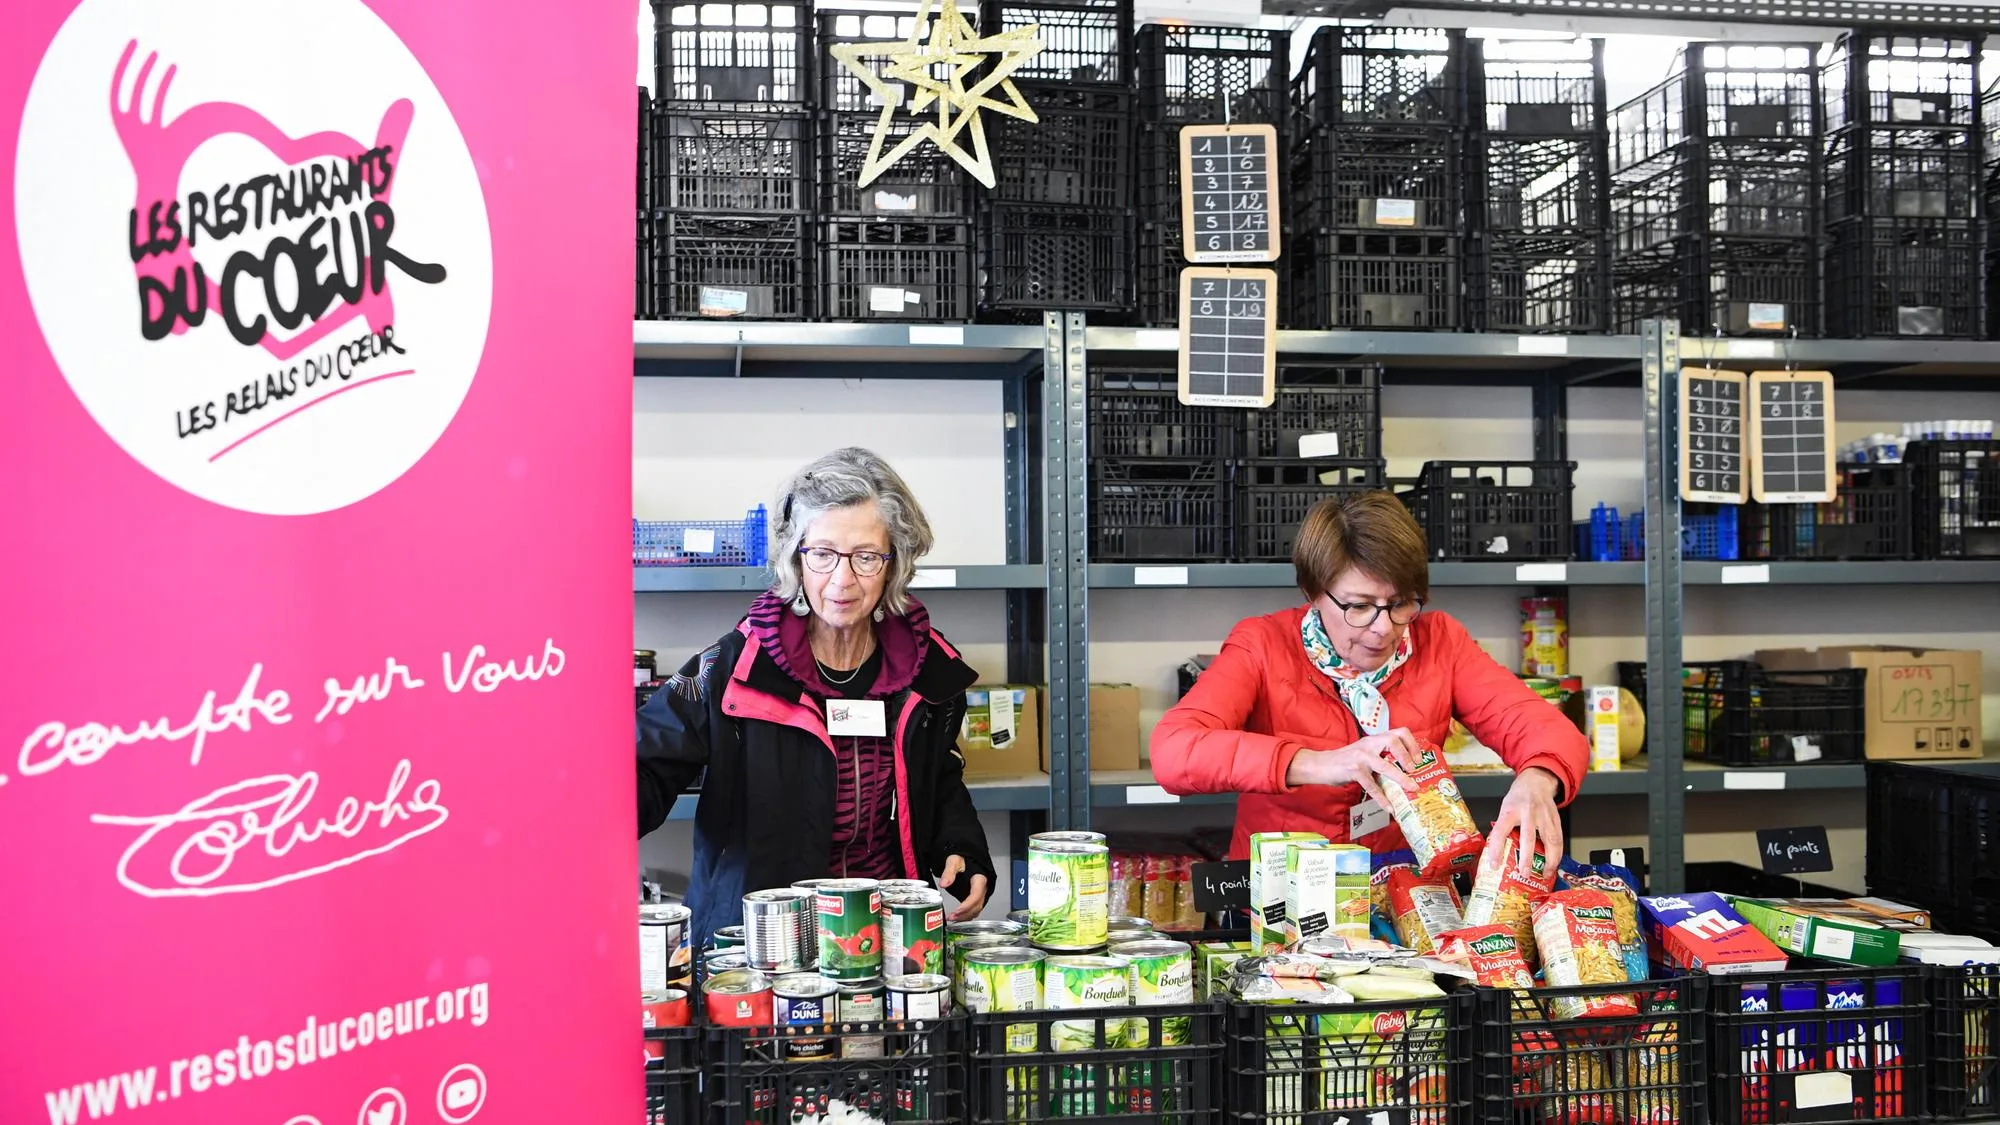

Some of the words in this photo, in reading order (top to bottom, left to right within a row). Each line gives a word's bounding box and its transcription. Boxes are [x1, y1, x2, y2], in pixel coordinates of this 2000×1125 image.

[1200, 139, 1211, 152] 1
[1240, 137, 1252, 153] 4
[1204, 158, 1215, 172] 2
[1240, 154, 1253, 170] 6
[1206, 176, 1218, 189] 3
[1241, 176, 1254, 189] 7
[129, 200, 183, 263] LES
[188, 145, 393, 248] RESTAURANTS
[1205, 196, 1216, 210] 4
[1207, 216, 1218, 229] 5
[1209, 235, 1220, 250] 6
[1242, 234, 1256, 250] 8
[1202, 282, 1215, 295] 7
[1234, 282, 1261, 299] 13
[138, 261, 207, 341] DU
[1200, 300, 1213, 315] 8
[177, 401, 217, 439] LES
[224, 366, 299, 423] RELAIS
[304, 353, 333, 388] DU
[314, 657, 425, 723] sur
[1787, 841, 1820, 860] points
[1206, 876, 1215, 894] 4
[1476, 935, 1517, 954] PANZANI
[1480, 957, 1525, 973] Macaroni
[791, 1009, 821, 1020] DUNE
[44, 982, 489, 1125] www.restosducoeur.org
